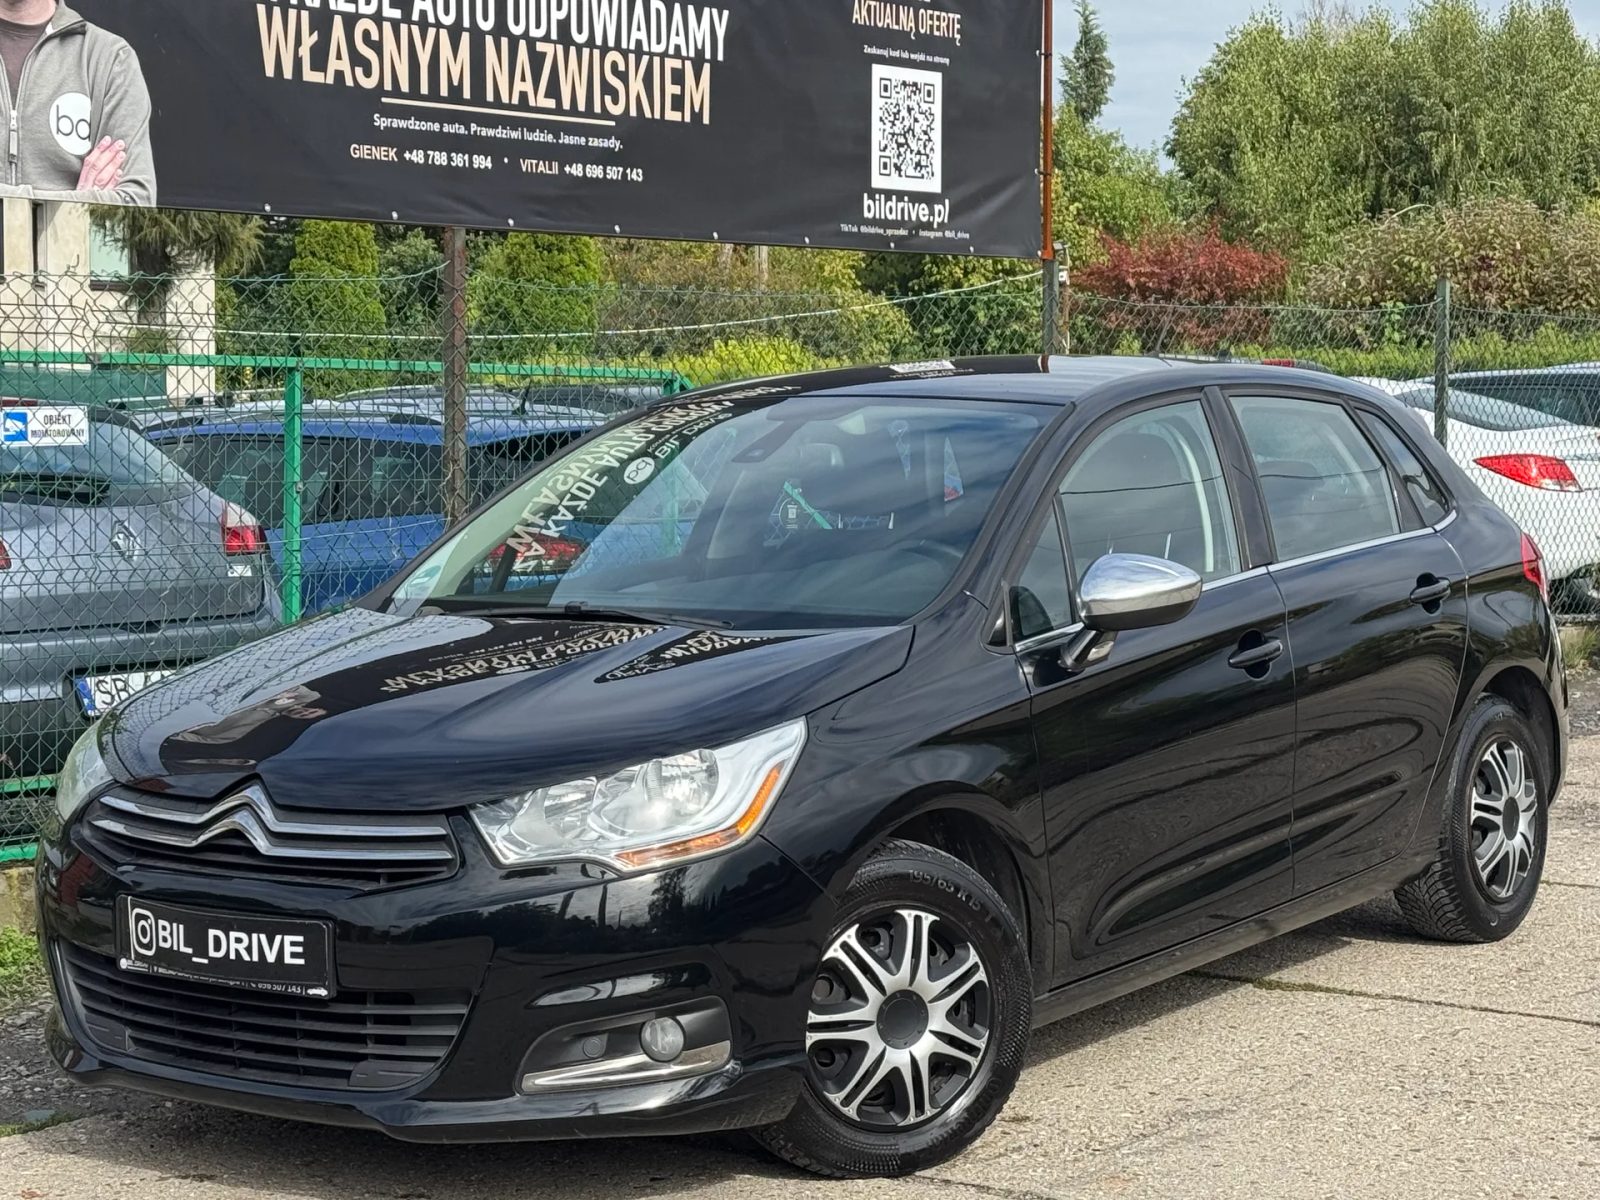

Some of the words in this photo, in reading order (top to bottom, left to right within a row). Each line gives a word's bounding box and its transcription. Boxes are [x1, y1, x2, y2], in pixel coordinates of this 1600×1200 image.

[507, 0, 729, 61] ODPOWIADAMY
[852, 0, 915, 39] AKTUALNĄ
[918, 8, 962, 46] OFERTĘ
[256, 3, 471, 100] WŁASNYM
[485, 34, 711, 125] NAZWISKIEM
[373, 113, 441, 132] Sprawdzone
[443, 123, 469, 135] auta.
[470, 123, 522, 140] Prawdziwi
[524, 129, 557, 143] ludzie.
[558, 132, 586, 146] Jasne
[588, 136, 623, 151] zasady.
[350, 143, 398, 162] GIENEK
[403, 151, 424, 165] +48
[427, 151, 448, 166] 788
[450, 153, 470, 168] 361
[472, 154, 492, 170] 994
[520, 158, 559, 175] VITALII
[564, 164, 583, 178] +48
[586, 164, 604, 179] 696
[606, 166, 624, 180] 507
[626, 167, 643, 182] 143
[863, 192, 950, 229] bildrive.pl
[157, 918, 306, 966] BIL_DRIVE
